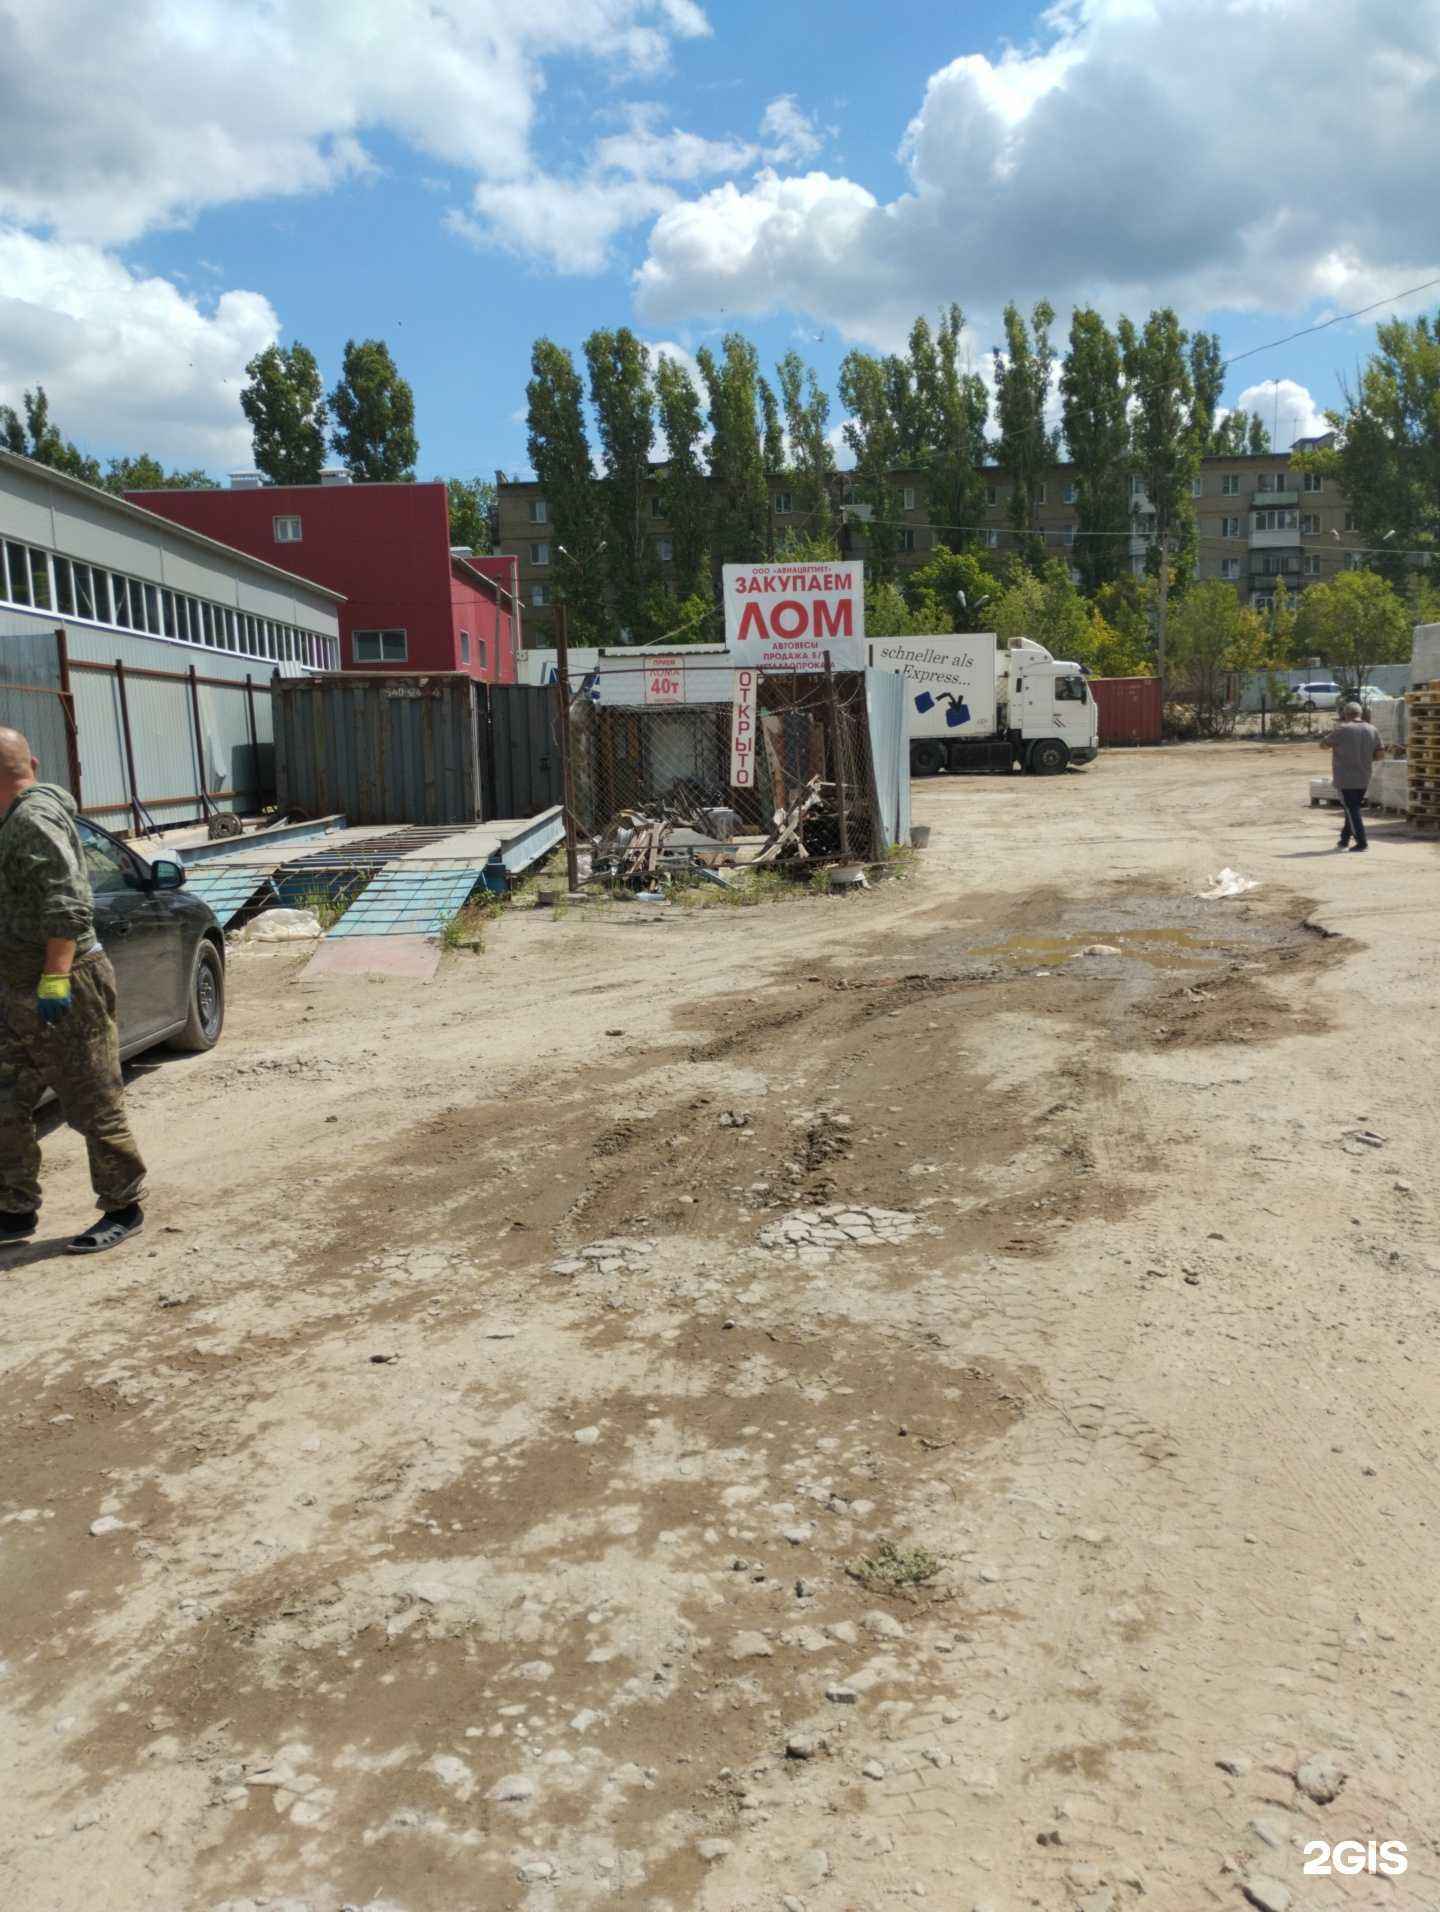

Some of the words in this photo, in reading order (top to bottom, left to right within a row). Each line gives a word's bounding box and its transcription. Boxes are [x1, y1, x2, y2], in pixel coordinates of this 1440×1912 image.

[735, 574, 853, 593] ЗАКУПАЕМ
[737, 599, 853, 640] ЛОМ
[763, 652, 809, 661] ПРОДАЖА
[772, 641, 818, 650] АВТОВЕСЫ
[880, 645, 949, 665] schneller
[951, 653, 975, 668] als
[903, 664, 971, 686] Express...
[735, 671, 752, 784] ОТКРЫТО
